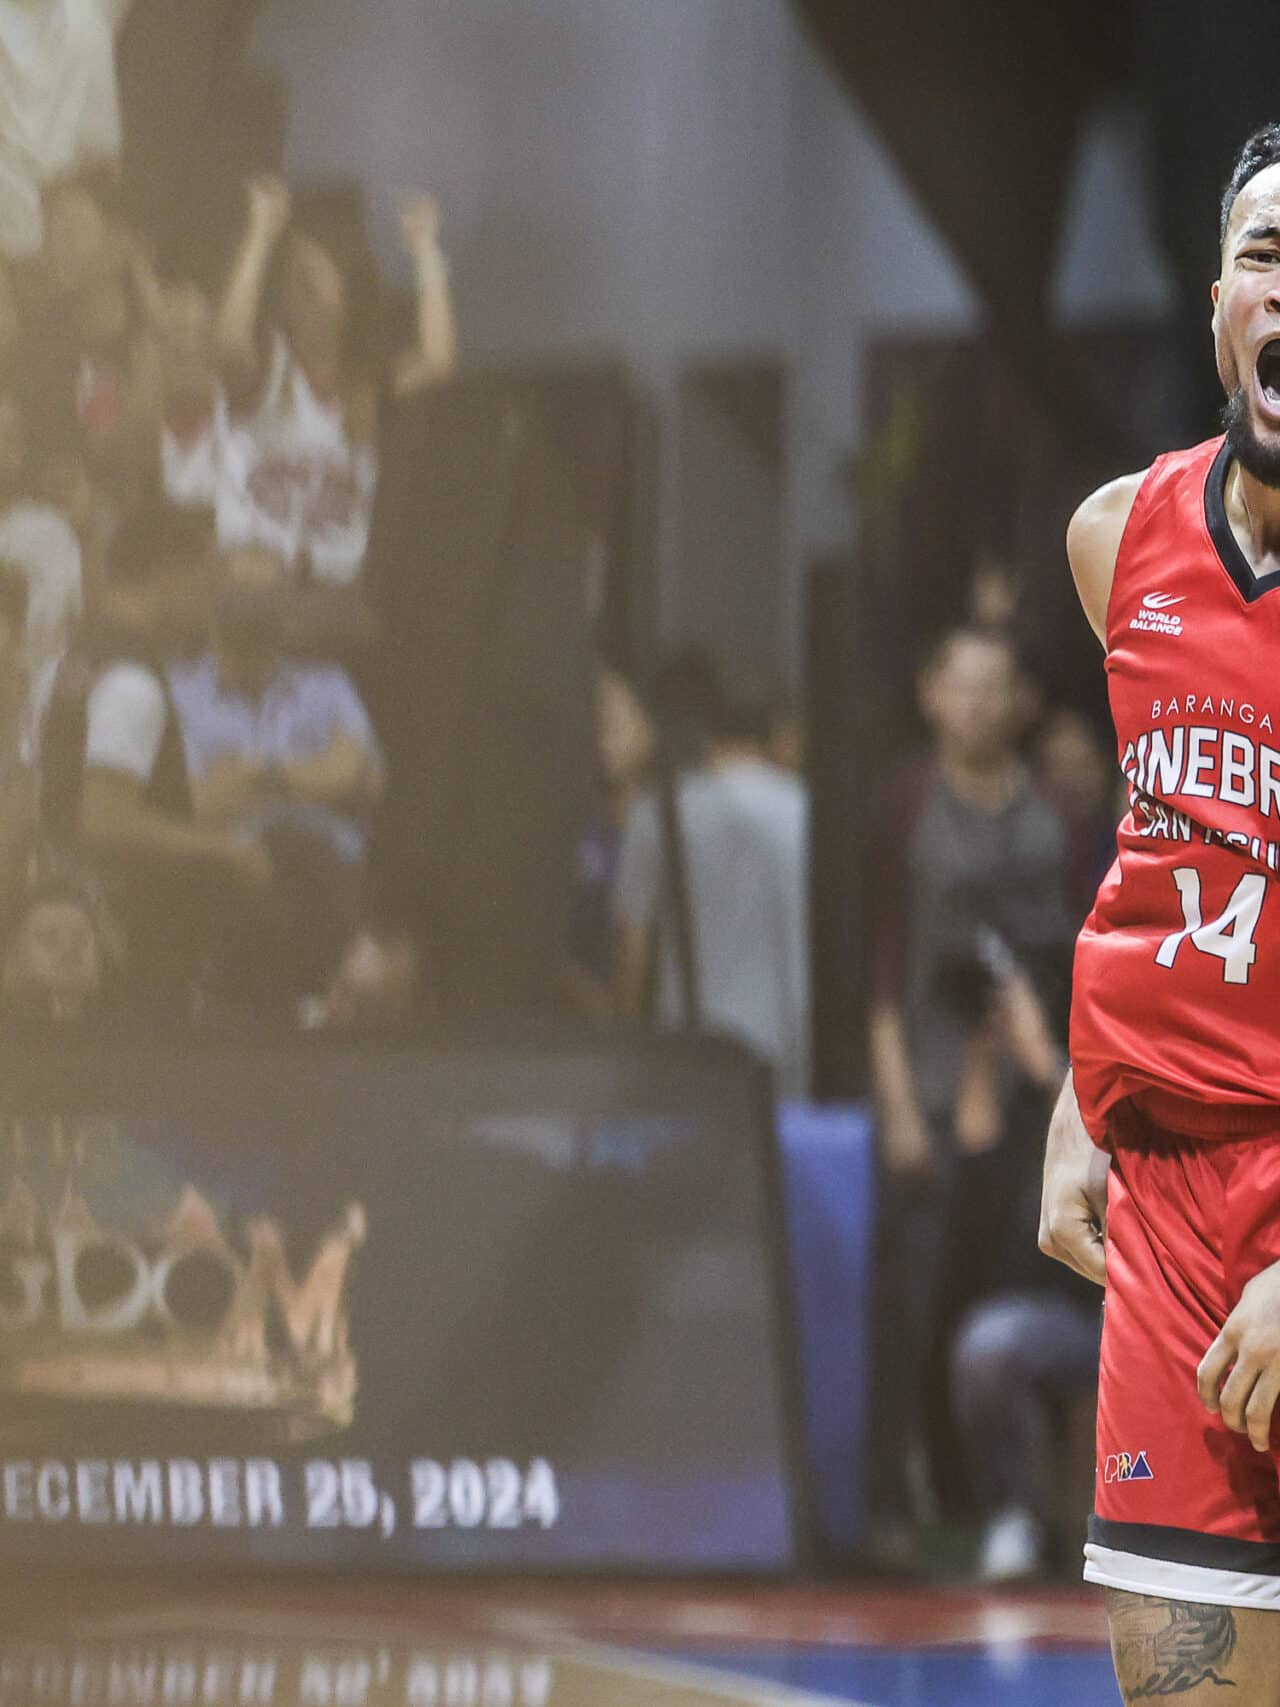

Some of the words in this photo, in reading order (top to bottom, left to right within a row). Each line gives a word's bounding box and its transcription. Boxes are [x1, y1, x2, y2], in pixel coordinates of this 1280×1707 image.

[1129, 619, 1184, 636] BALANCE
[1138, 609, 1182, 625] WORLD
[1153, 866, 1269, 985] 14
[304, 1457, 395, 1539] 25,
[409, 1455, 559, 1529] 2024
